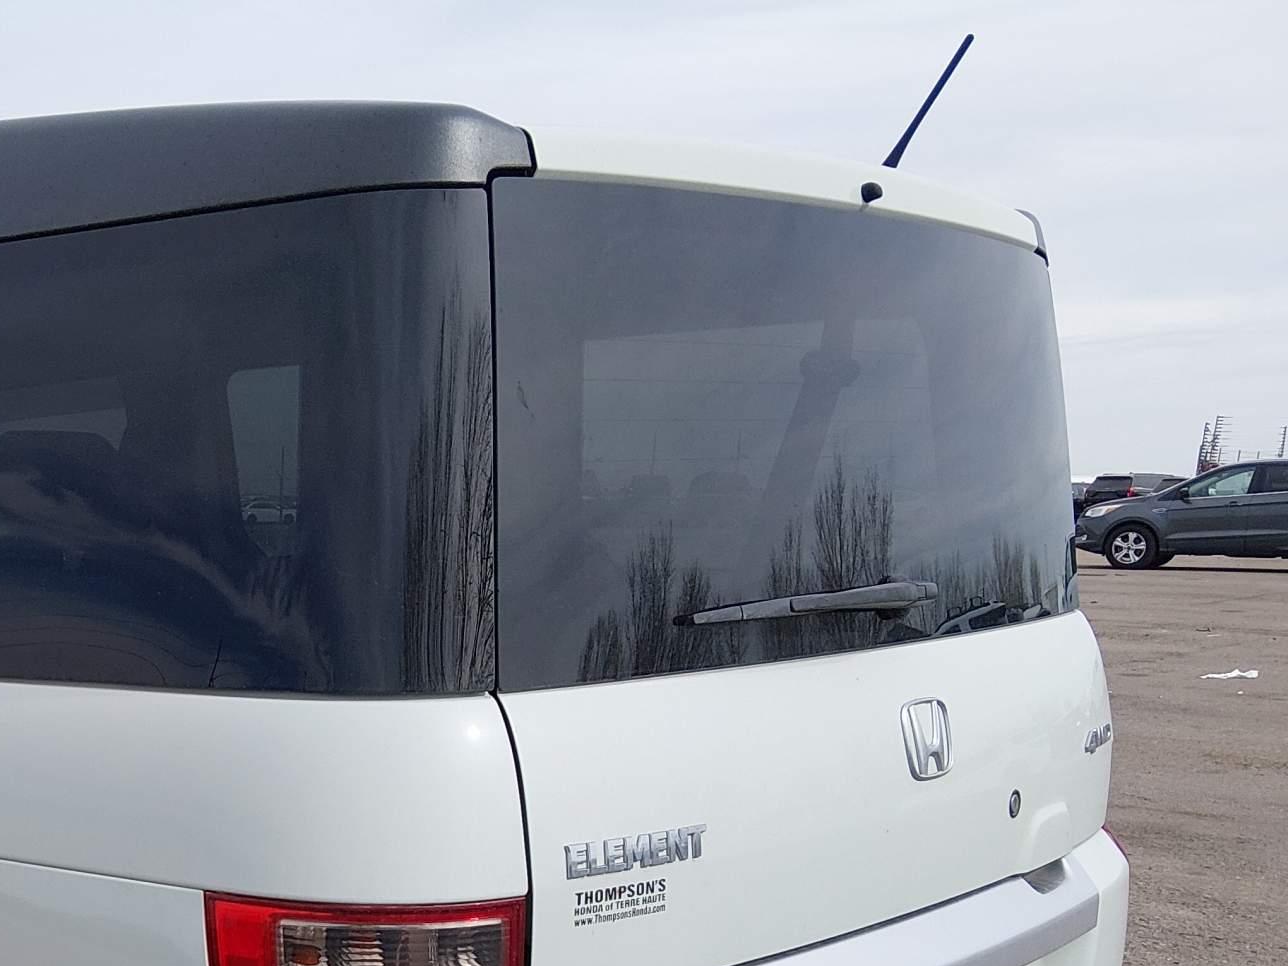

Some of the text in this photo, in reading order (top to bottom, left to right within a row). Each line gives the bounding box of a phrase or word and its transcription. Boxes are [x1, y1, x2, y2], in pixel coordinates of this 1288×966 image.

[563, 823, 708, 880] ELEMENT
[574, 893, 666, 916] HONDA of TERRE HAUTE
[575, 879, 666, 906] THOMPSON'S
